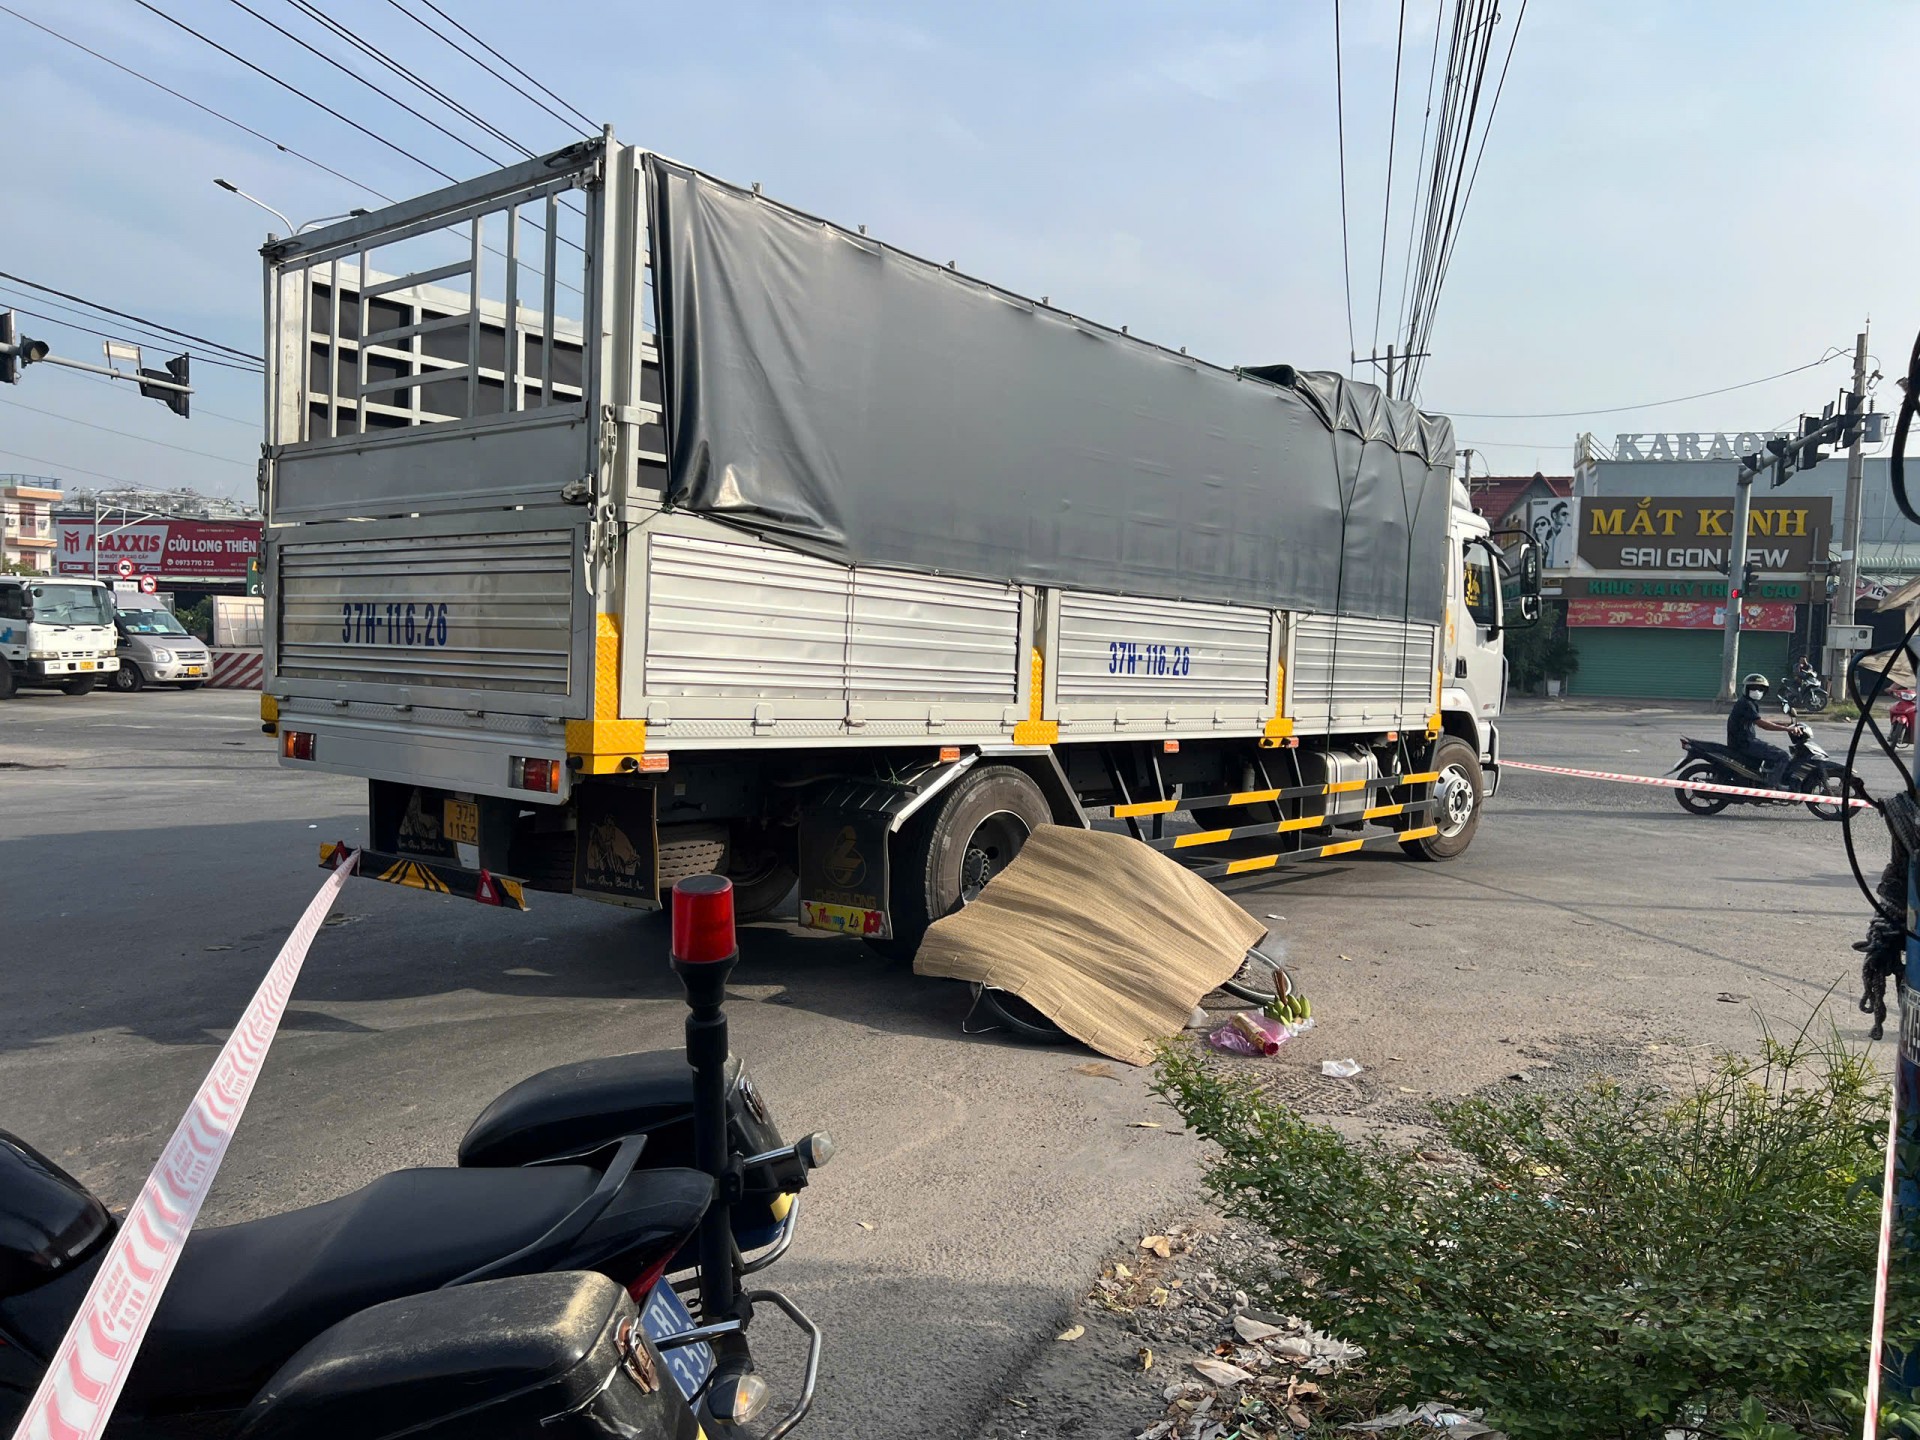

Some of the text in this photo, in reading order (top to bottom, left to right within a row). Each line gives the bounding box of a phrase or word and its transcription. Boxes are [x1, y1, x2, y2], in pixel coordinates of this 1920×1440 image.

[1616, 432, 1805, 461] KARAO
[1589, 497, 1809, 536] MẮT KNH
[168, 534, 256, 552] CỬU LONG THIÊN
[1620, 547, 1661, 567] SAI
[1730, 549, 1789, 569] EW
[342, 602, 447, 646] 37H-116.26
[1109, 642, 1190, 676] 37H-116.26
[456, 804, 476, 823] 37H
